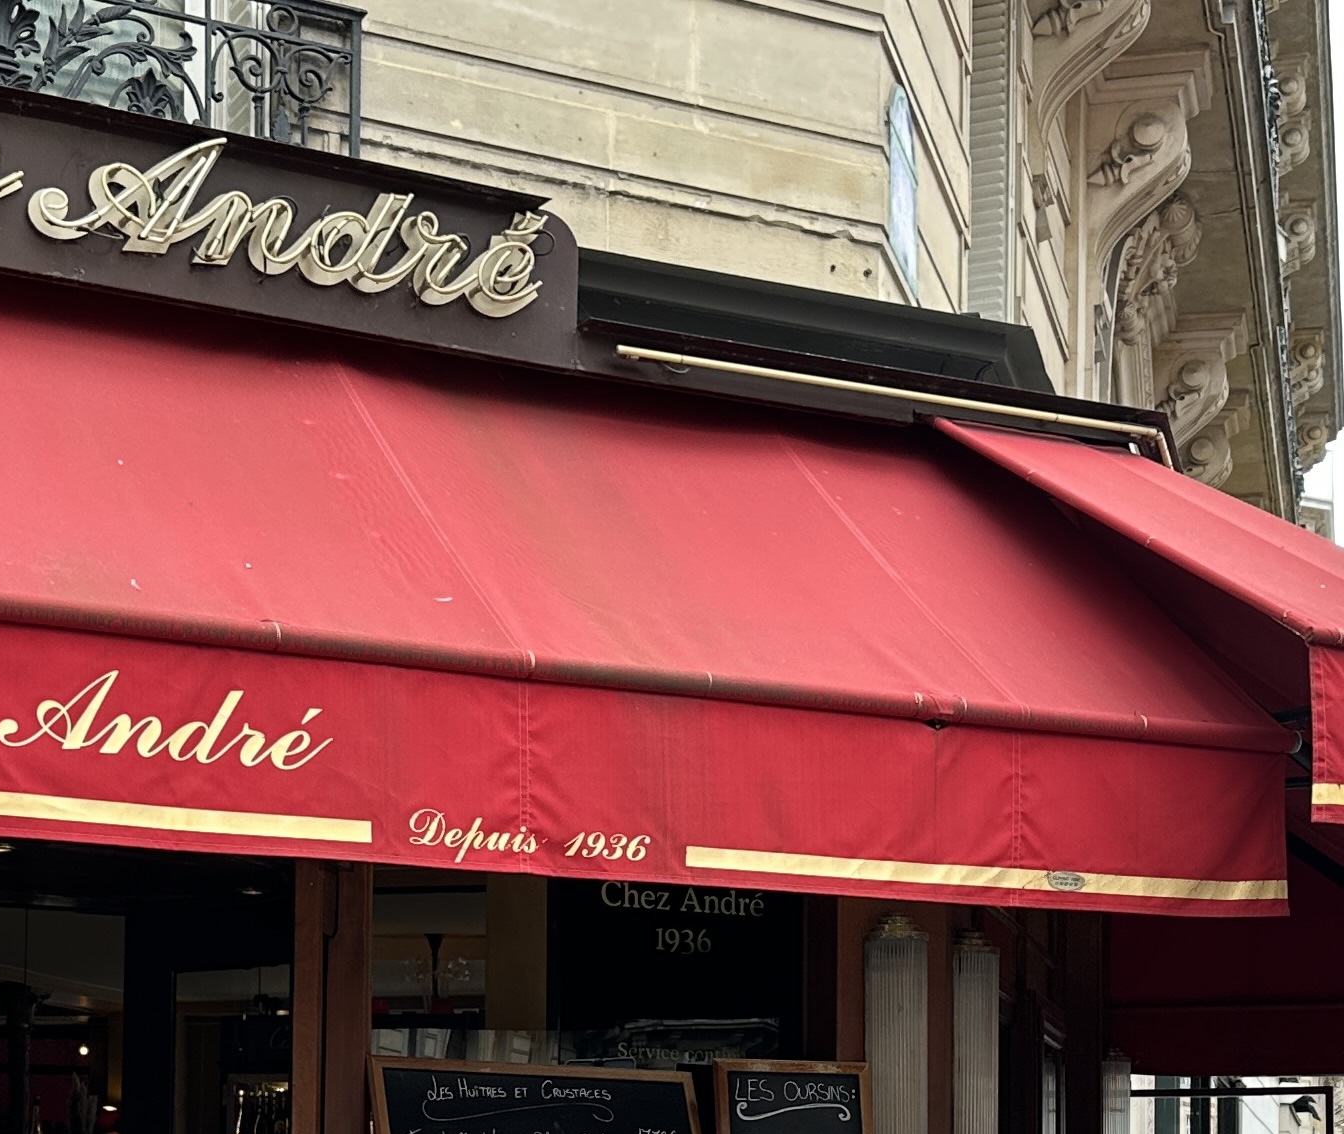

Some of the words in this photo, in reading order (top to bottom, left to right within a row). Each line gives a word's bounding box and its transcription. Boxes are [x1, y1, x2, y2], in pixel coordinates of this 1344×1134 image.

[28, 137, 546, 319] André
[409, 807, 540, 864] Depuis
[563, 831, 651, 862] 1936
[601, 881, 671, 911] Chez
[680, 886, 765, 917] André
[656, 927, 712, 955] 1936
[427, 1075, 454, 1101] LES
[515, 1086, 529, 1099] ET
[735, 1077, 775, 1102] LES
